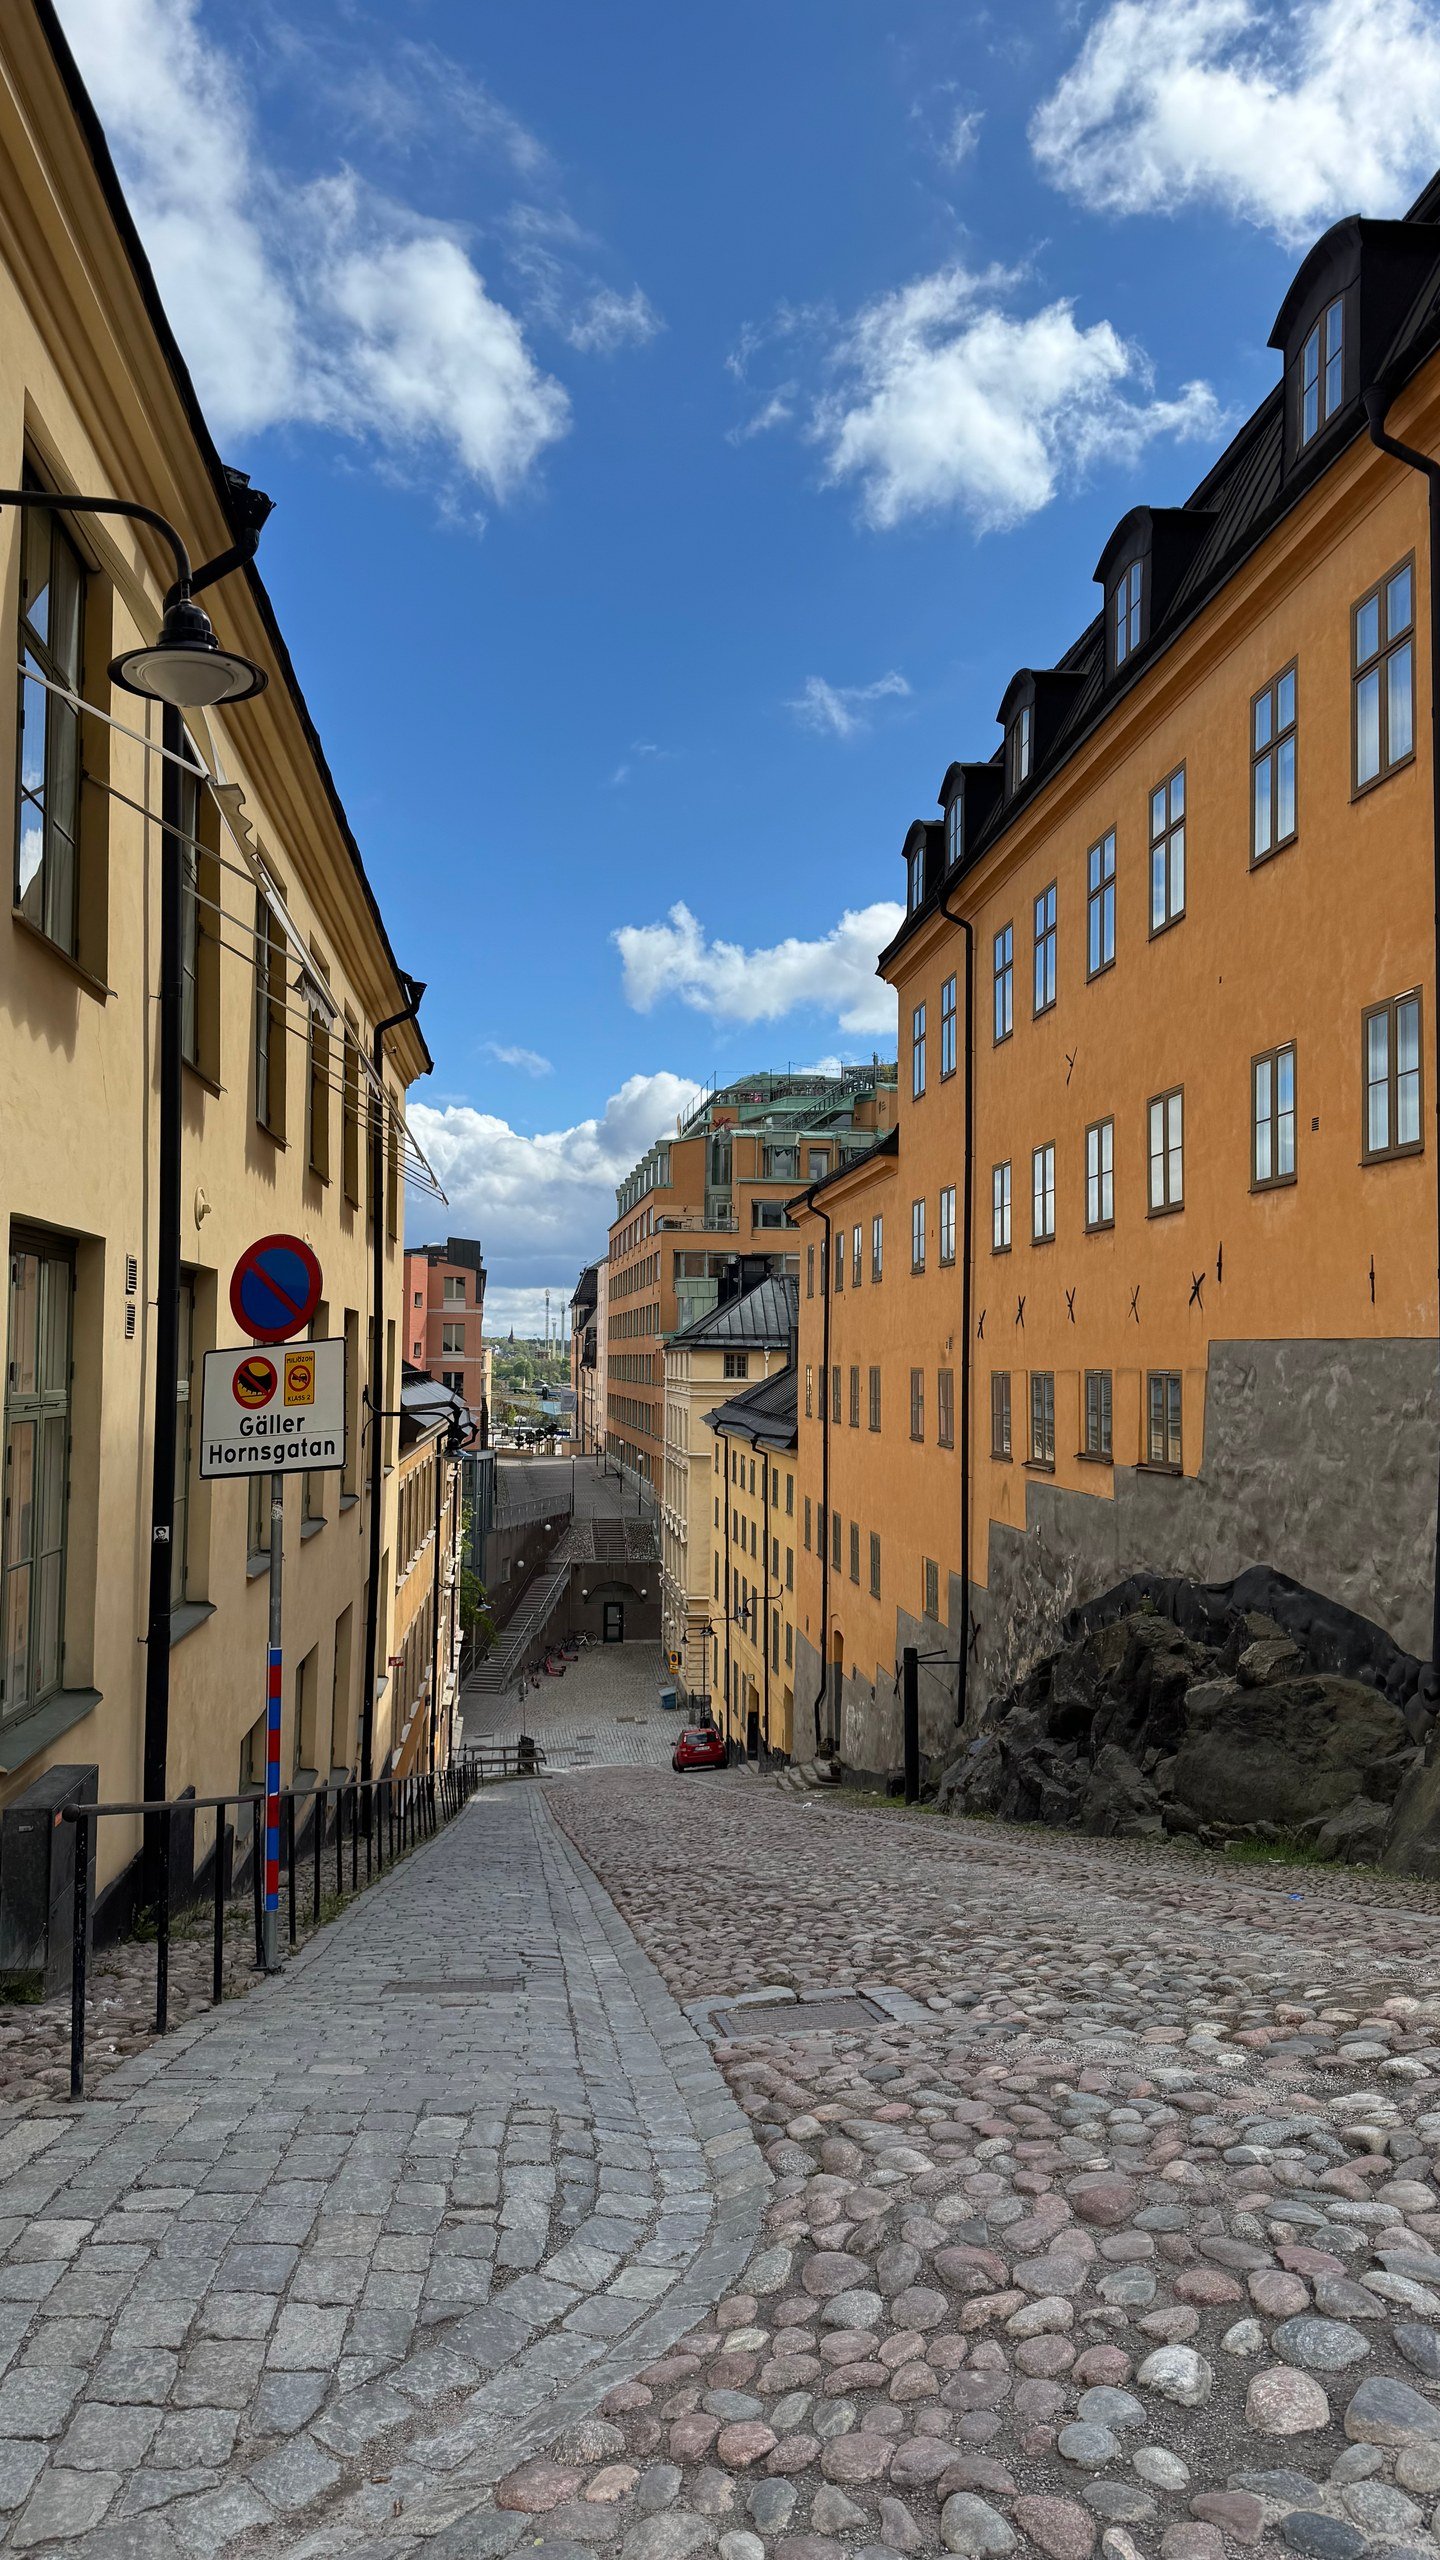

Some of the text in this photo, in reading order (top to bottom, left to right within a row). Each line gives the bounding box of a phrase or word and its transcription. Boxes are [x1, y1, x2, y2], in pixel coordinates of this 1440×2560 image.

[287, 1355, 313, 1363] MILJÖZON
[240, 1414, 305, 1436] Gäller
[209, 1438, 335, 1464] Hornsgatan
